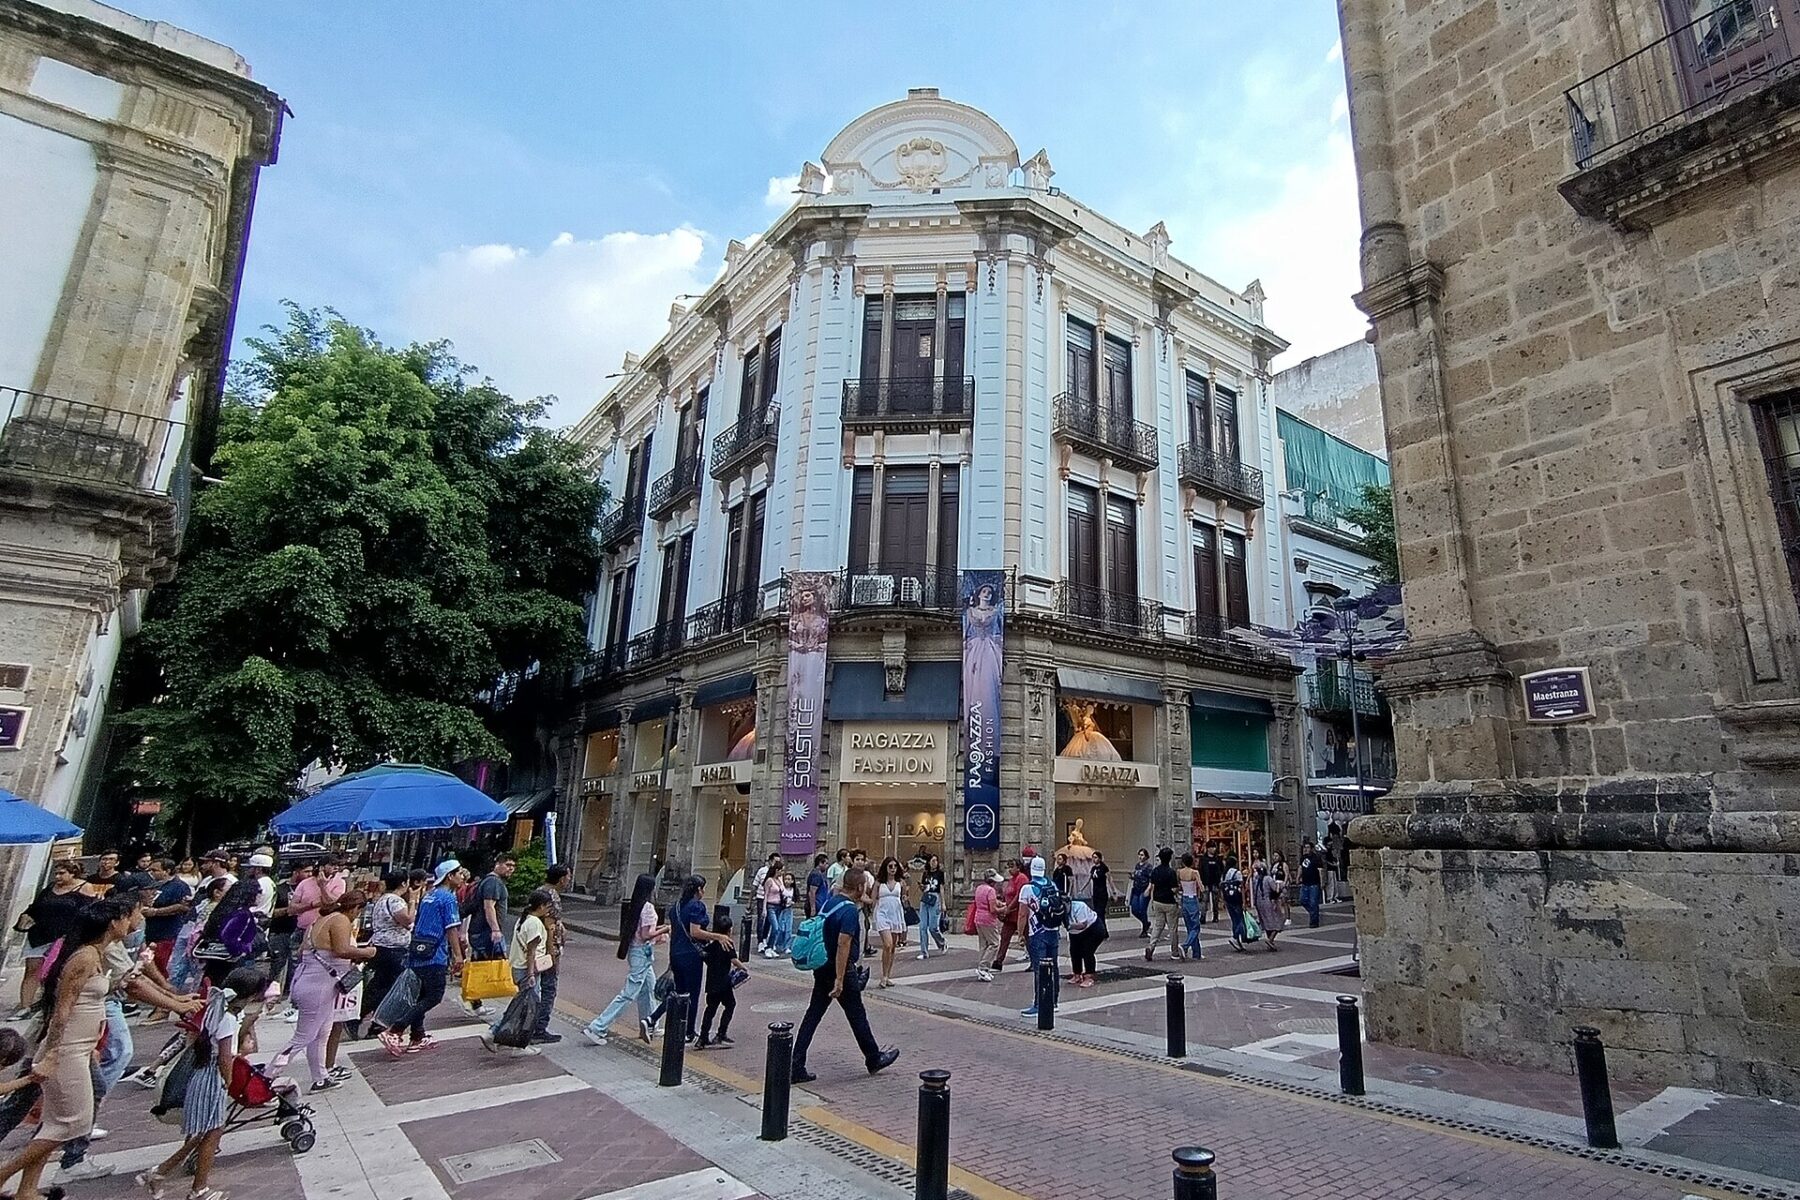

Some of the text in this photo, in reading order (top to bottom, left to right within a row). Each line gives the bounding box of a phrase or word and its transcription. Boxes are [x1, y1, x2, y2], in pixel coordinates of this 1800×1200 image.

[1533, 689, 1579, 702] Maestranza
[793, 697, 815, 788] SOLSTICE
[851, 732, 936, 749] RAGAZZA
[985, 718, 994, 773] FASHION
[852, 756, 934, 773] FASHION
[1081, 764, 1142, 783] RAGAZZA
